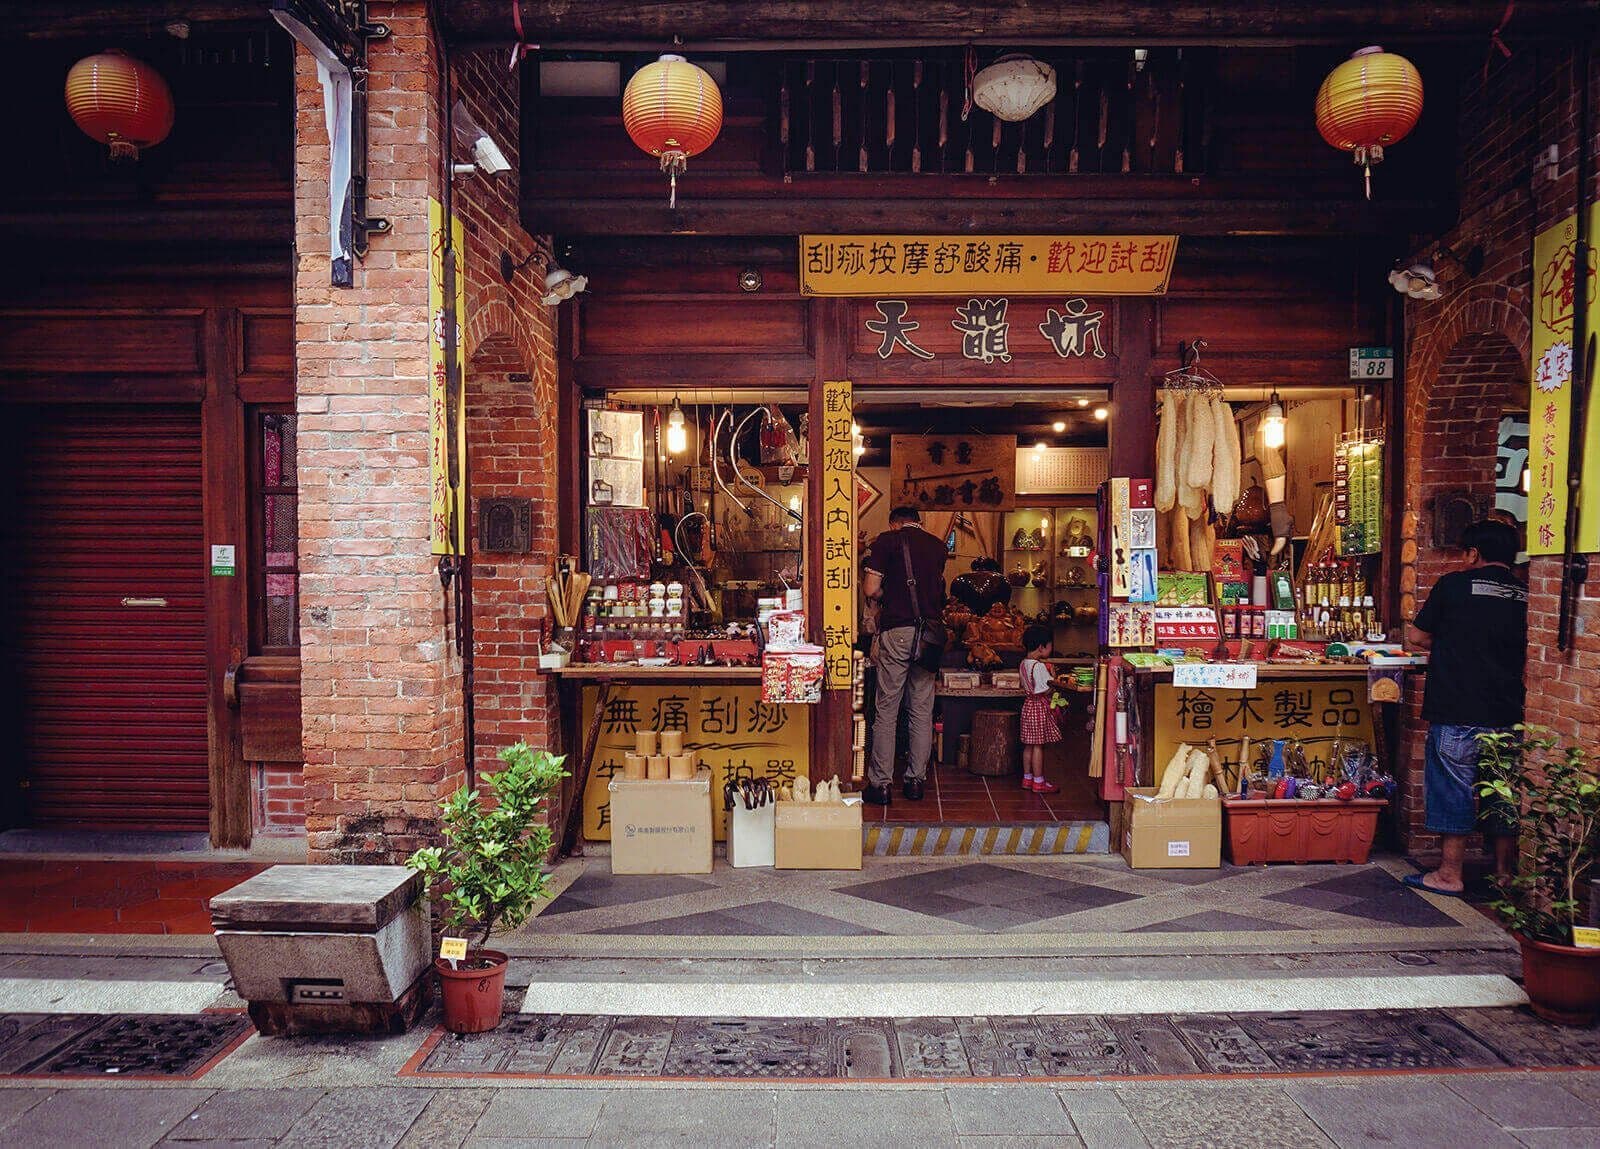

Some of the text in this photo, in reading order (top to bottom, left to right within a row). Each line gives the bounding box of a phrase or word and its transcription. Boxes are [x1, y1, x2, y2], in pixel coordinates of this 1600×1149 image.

[1366, 361, 1385, 376] 88
[1175, 688, 1361, 730] 檜木製品
